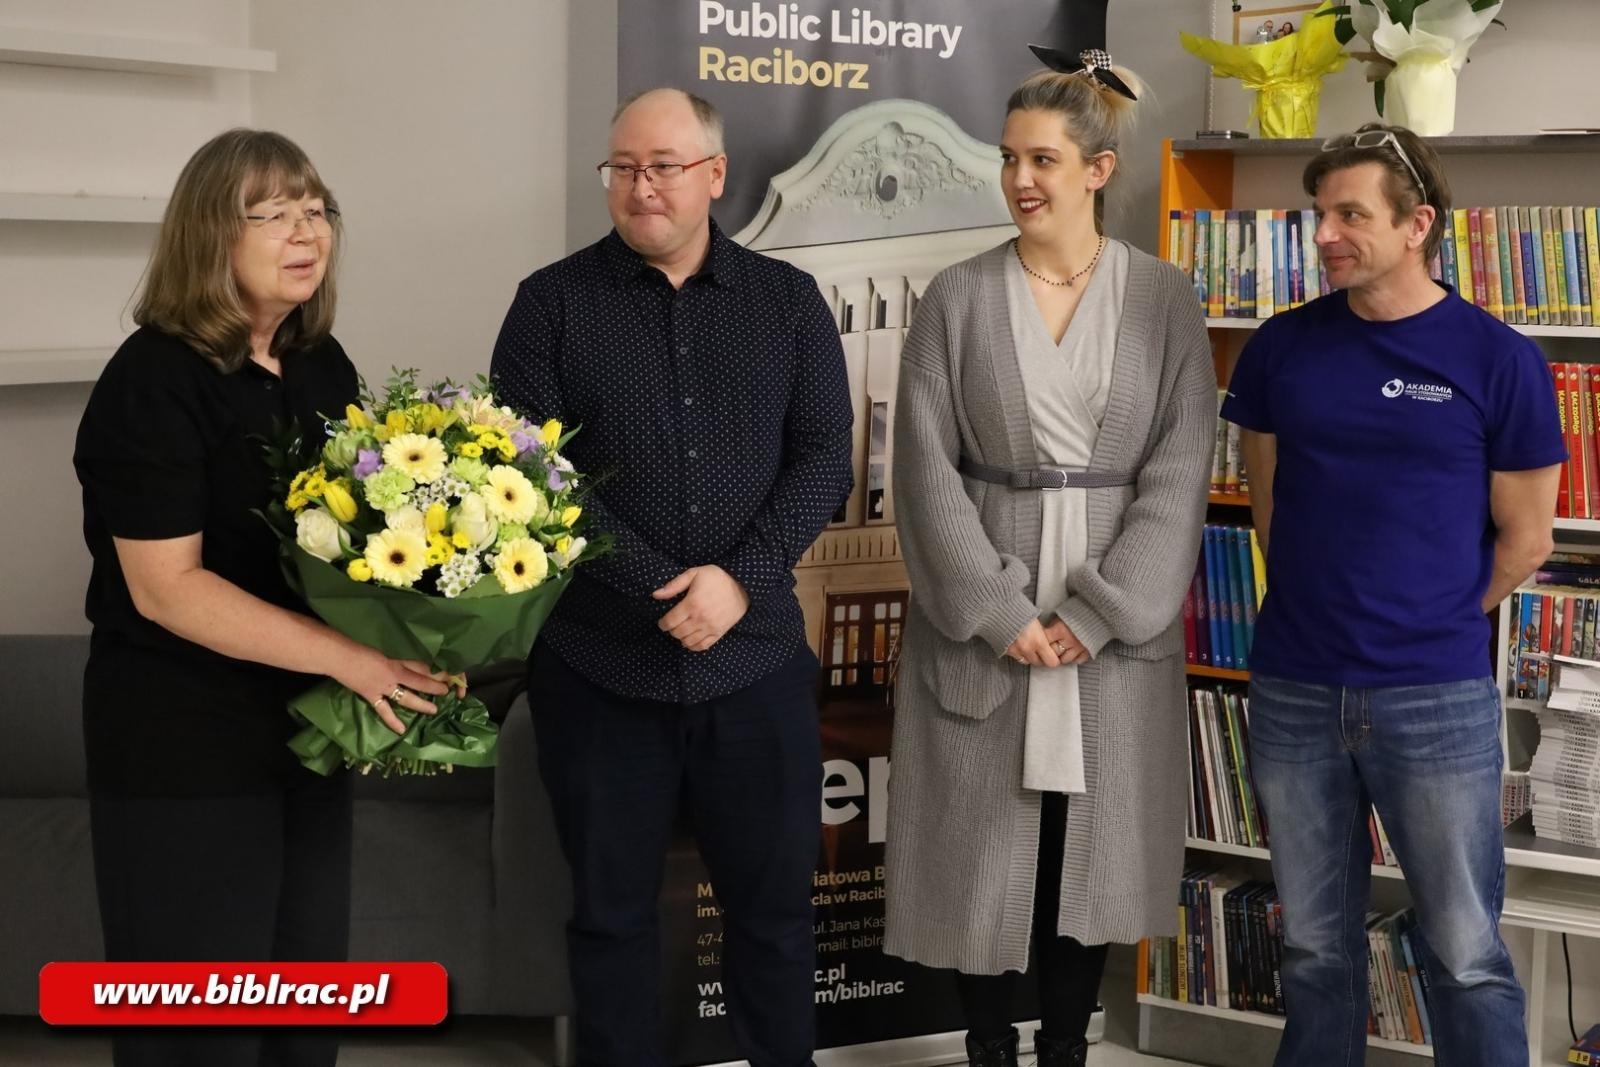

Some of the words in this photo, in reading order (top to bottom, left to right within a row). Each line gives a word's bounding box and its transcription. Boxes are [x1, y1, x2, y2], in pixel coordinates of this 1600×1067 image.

[699, 1, 821, 42] Public
[831, 8, 963, 59] Library
[699, 46, 870, 89] Raciborz
[1406, 384, 1453, 395] AKADEMIA
[834, 893, 848, 904] w
[829, 919, 860, 933] Jana
